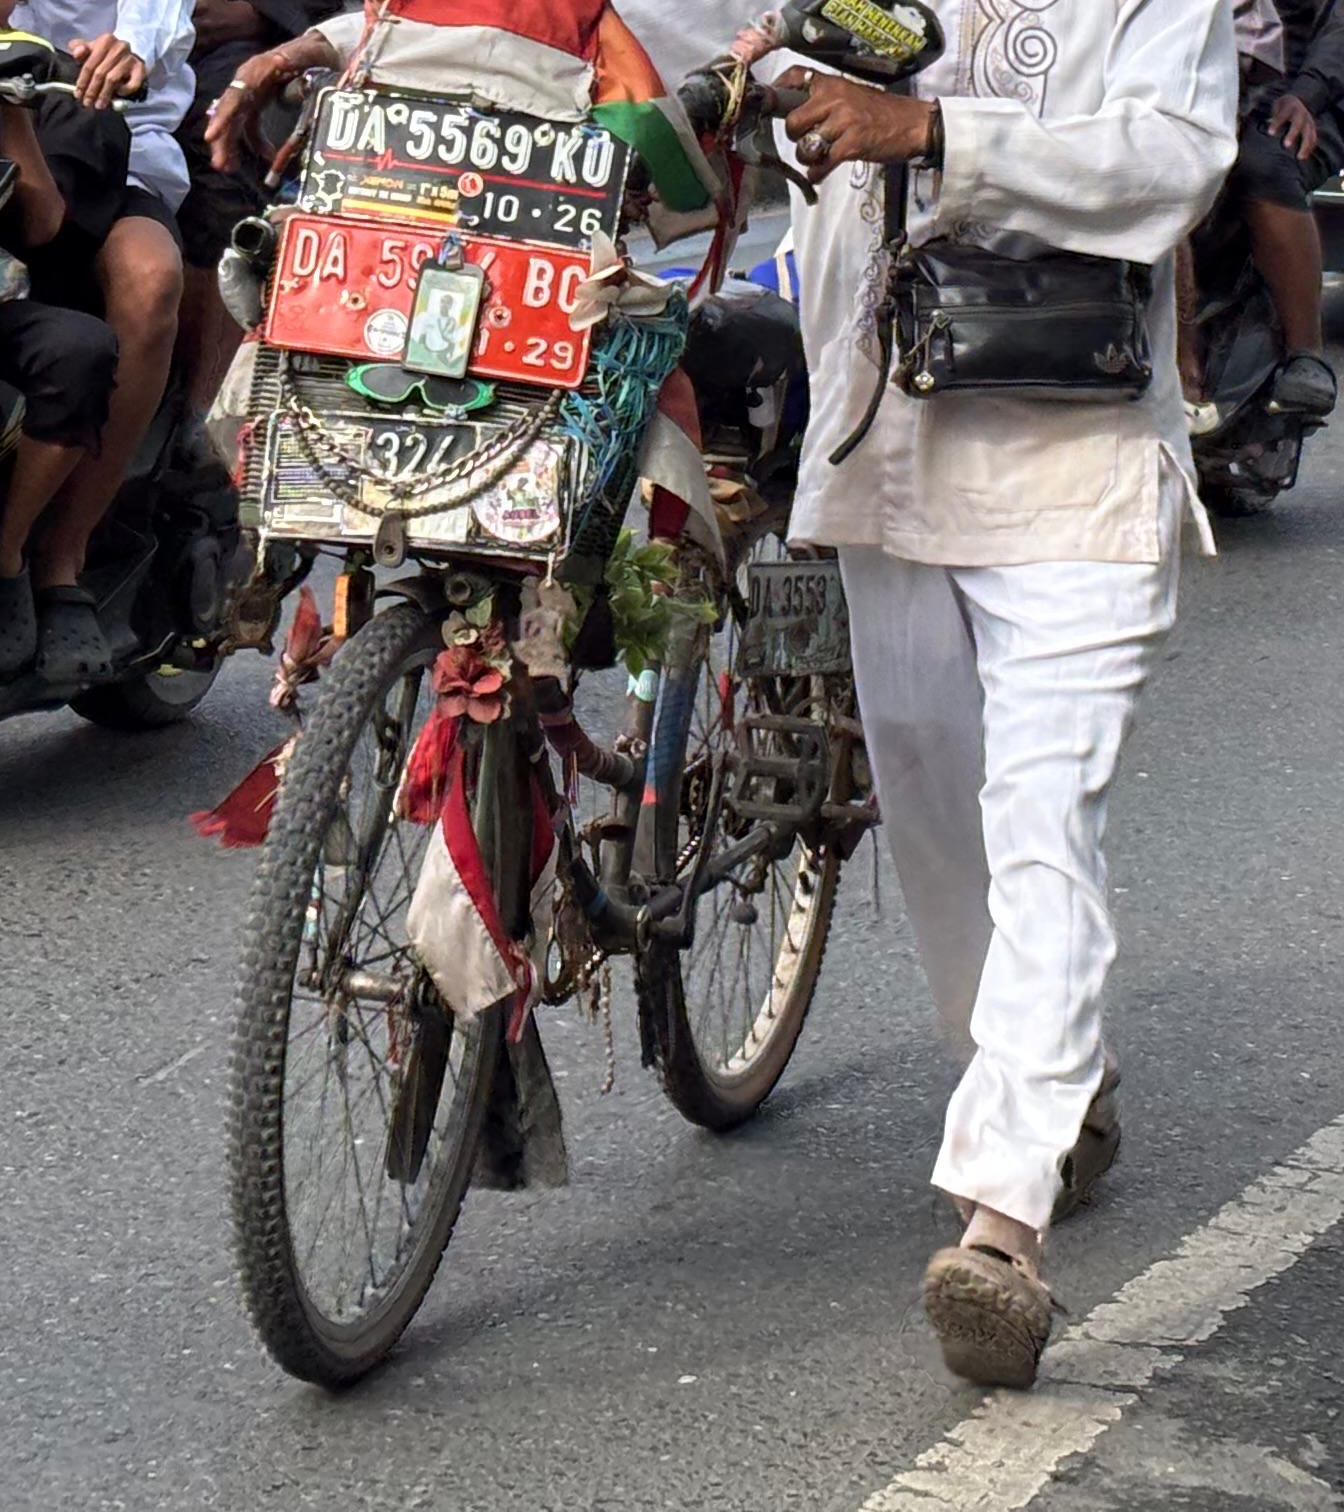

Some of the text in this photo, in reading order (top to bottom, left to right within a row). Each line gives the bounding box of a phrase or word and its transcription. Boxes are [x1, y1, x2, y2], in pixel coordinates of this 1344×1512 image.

[326, 97, 386, 155] DA
[405, 110, 532, 175] 5569
[291, 227, 347, 282] DA
